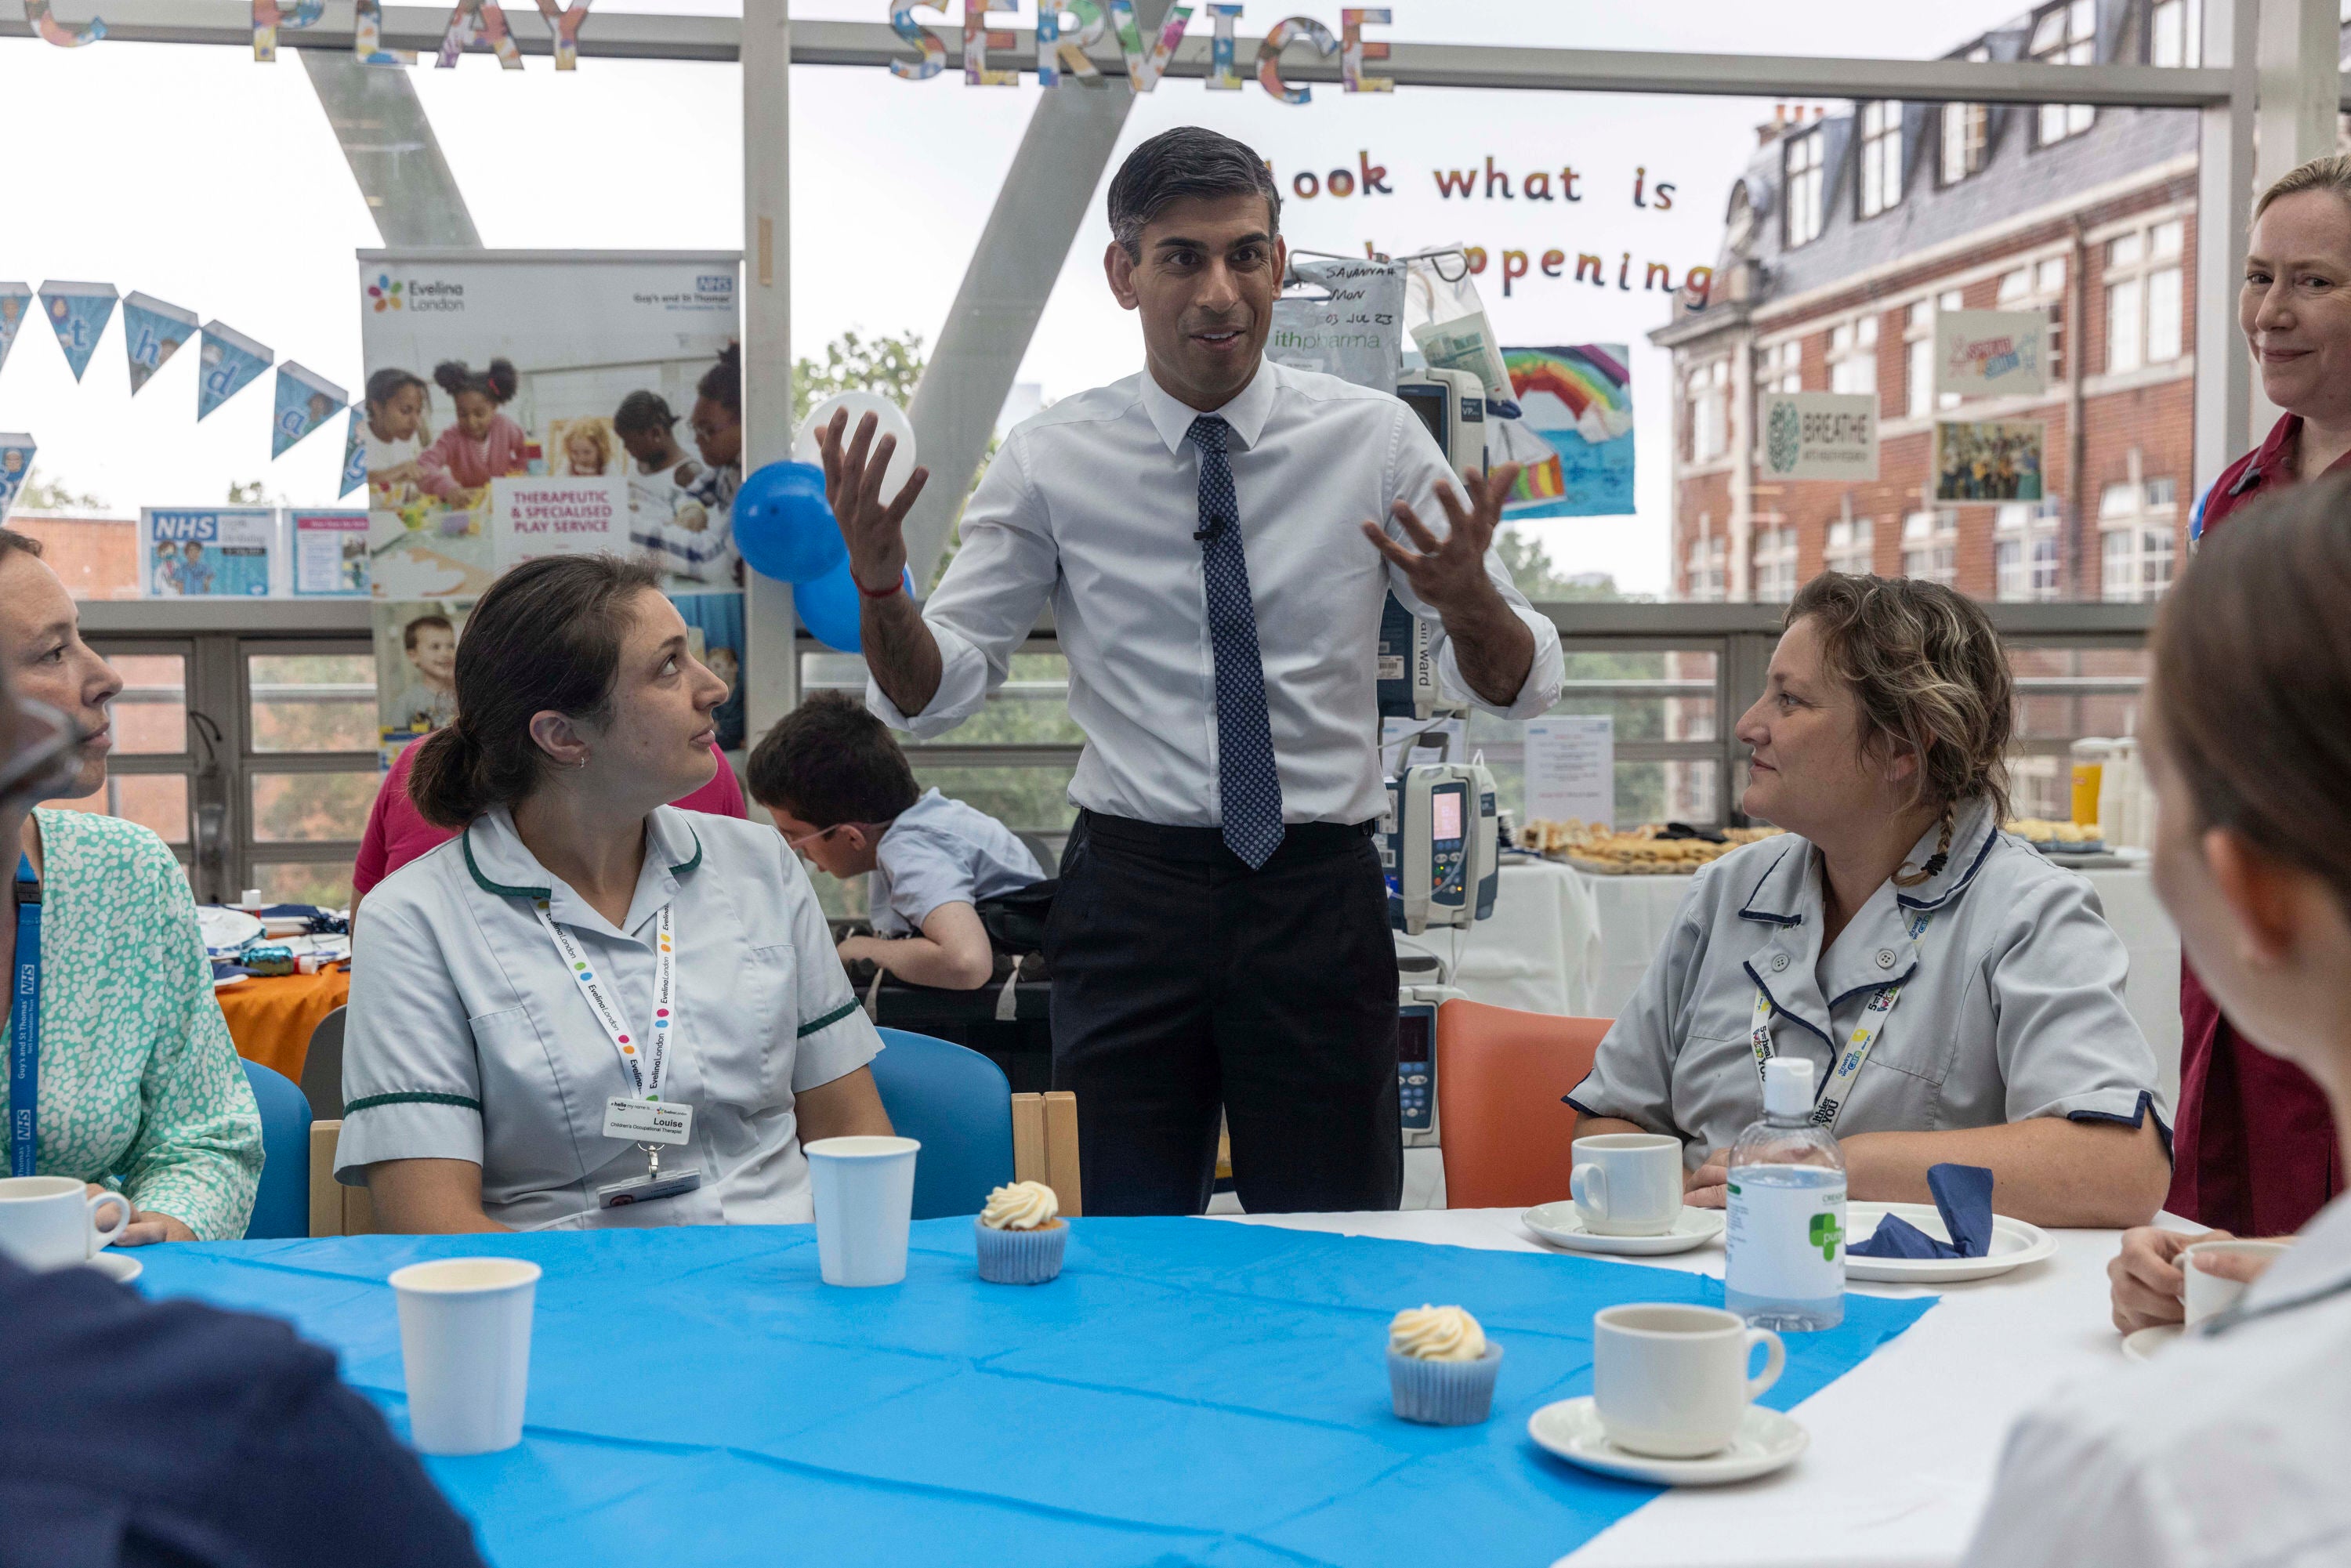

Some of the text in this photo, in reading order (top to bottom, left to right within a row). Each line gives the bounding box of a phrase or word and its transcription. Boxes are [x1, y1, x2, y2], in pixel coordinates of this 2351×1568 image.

[252, 0, 596, 71] PLAY
[890, 0, 1395, 104] SERVICE
[1433, 155, 1581, 201] what
[1633, 167, 1677, 210] is
[1326, 266, 1397, 279] SAVANNAH
[408, 279, 464, 295] Evelina
[409, 295, 465, 313] London
[1346, 313, 1370, 324] JUL
[1804, 413, 1867, 444] BREATHE
[513, 490, 609, 504] THERAPEUTIC
[525, 504, 613, 518] SPECIALISED
[156, 516, 215, 539] NHS
[514, 519, 610, 533] PLAY SERVICE
[1418, 649, 1432, 687] ward
[21, 965, 34, 994] NHS
[19, 1030, 27, 1041] St
[18, 1058, 27, 1080] Guy's
[1838, 1052, 1853, 1075] showing
[1848, 1050, 1863, 1071] care
[1821, 1099, 1838, 1123] YOU
[17, 1109, 31, 1140] NHS
[653, 1117, 683, 1128] Louise
